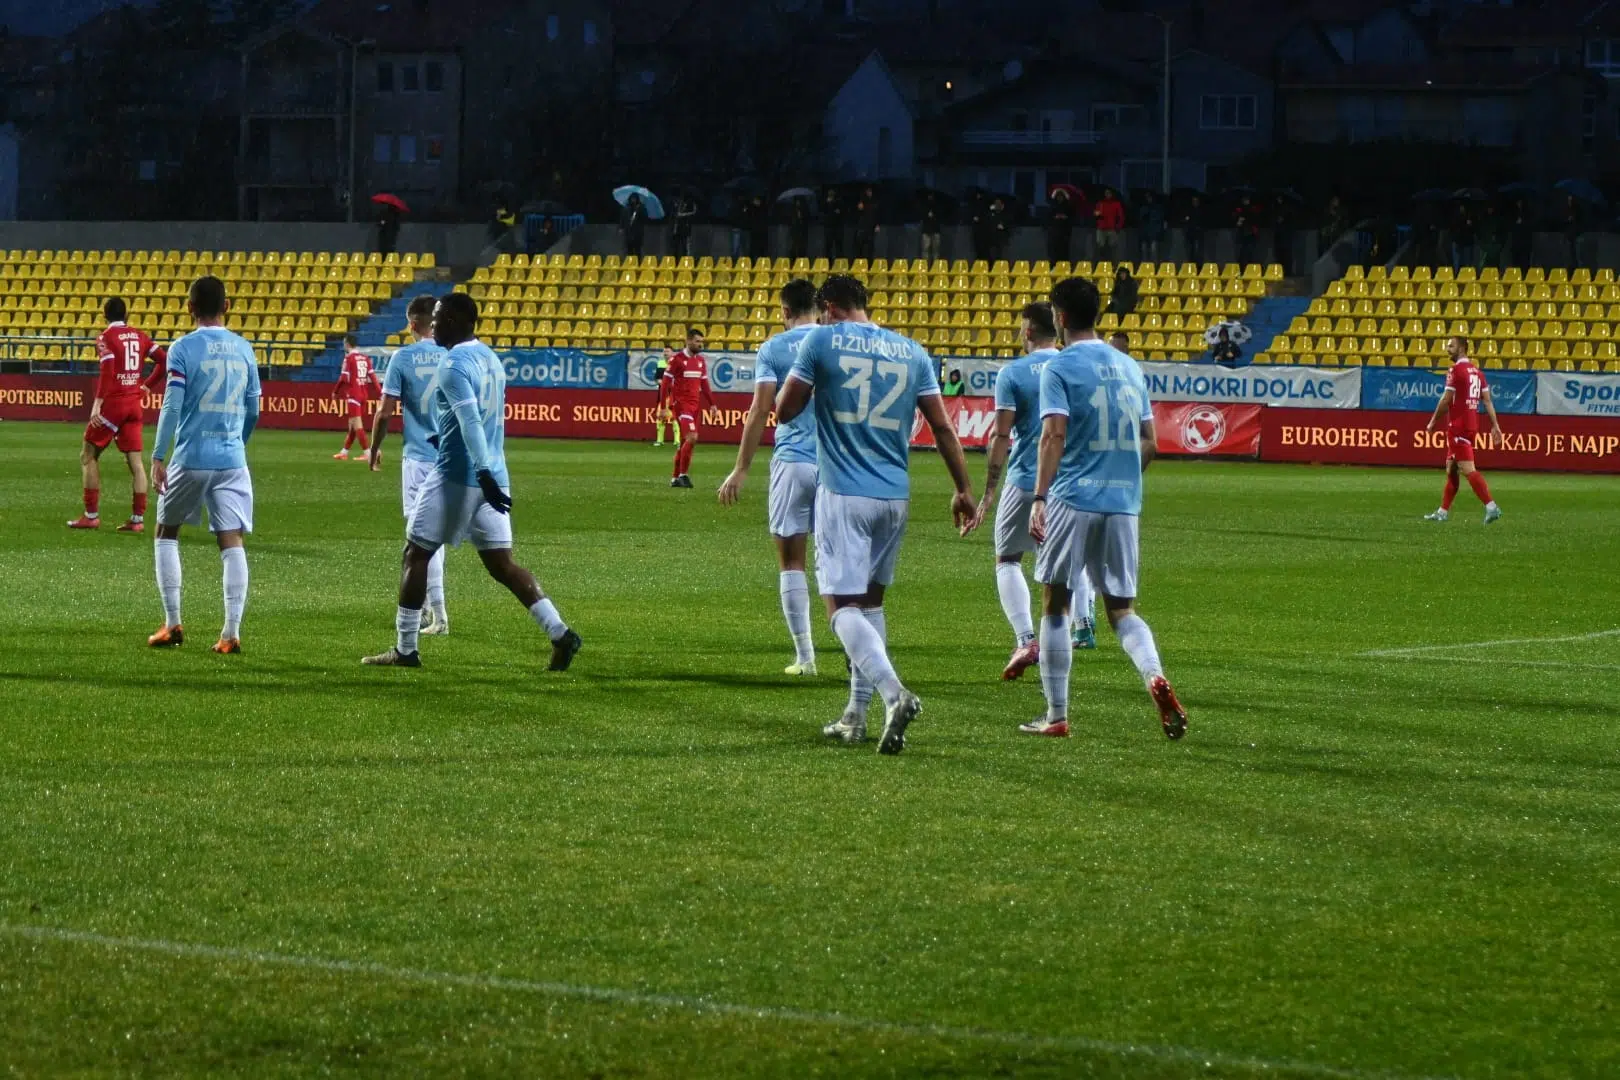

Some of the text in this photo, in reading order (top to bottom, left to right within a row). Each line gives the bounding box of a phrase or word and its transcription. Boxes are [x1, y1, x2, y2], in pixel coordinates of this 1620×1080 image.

[123, 341, 139, 371] 15
[502, 357, 608, 383] GoodLife
[415, 367, 438, 414] 7
[833, 356, 907, 431] 32
[1173, 376, 1246, 397] MOKRI
[1253, 379, 1335, 399] DOLAC
[268, 397, 298, 413] KAD
[301, 397, 315, 416] JE
[573, 405, 640, 424] SIGURNI
[1281, 426, 1398, 448] EUROHERC
[1501, 433, 1541, 451] KAD
[1545, 435, 1565, 456] JE
